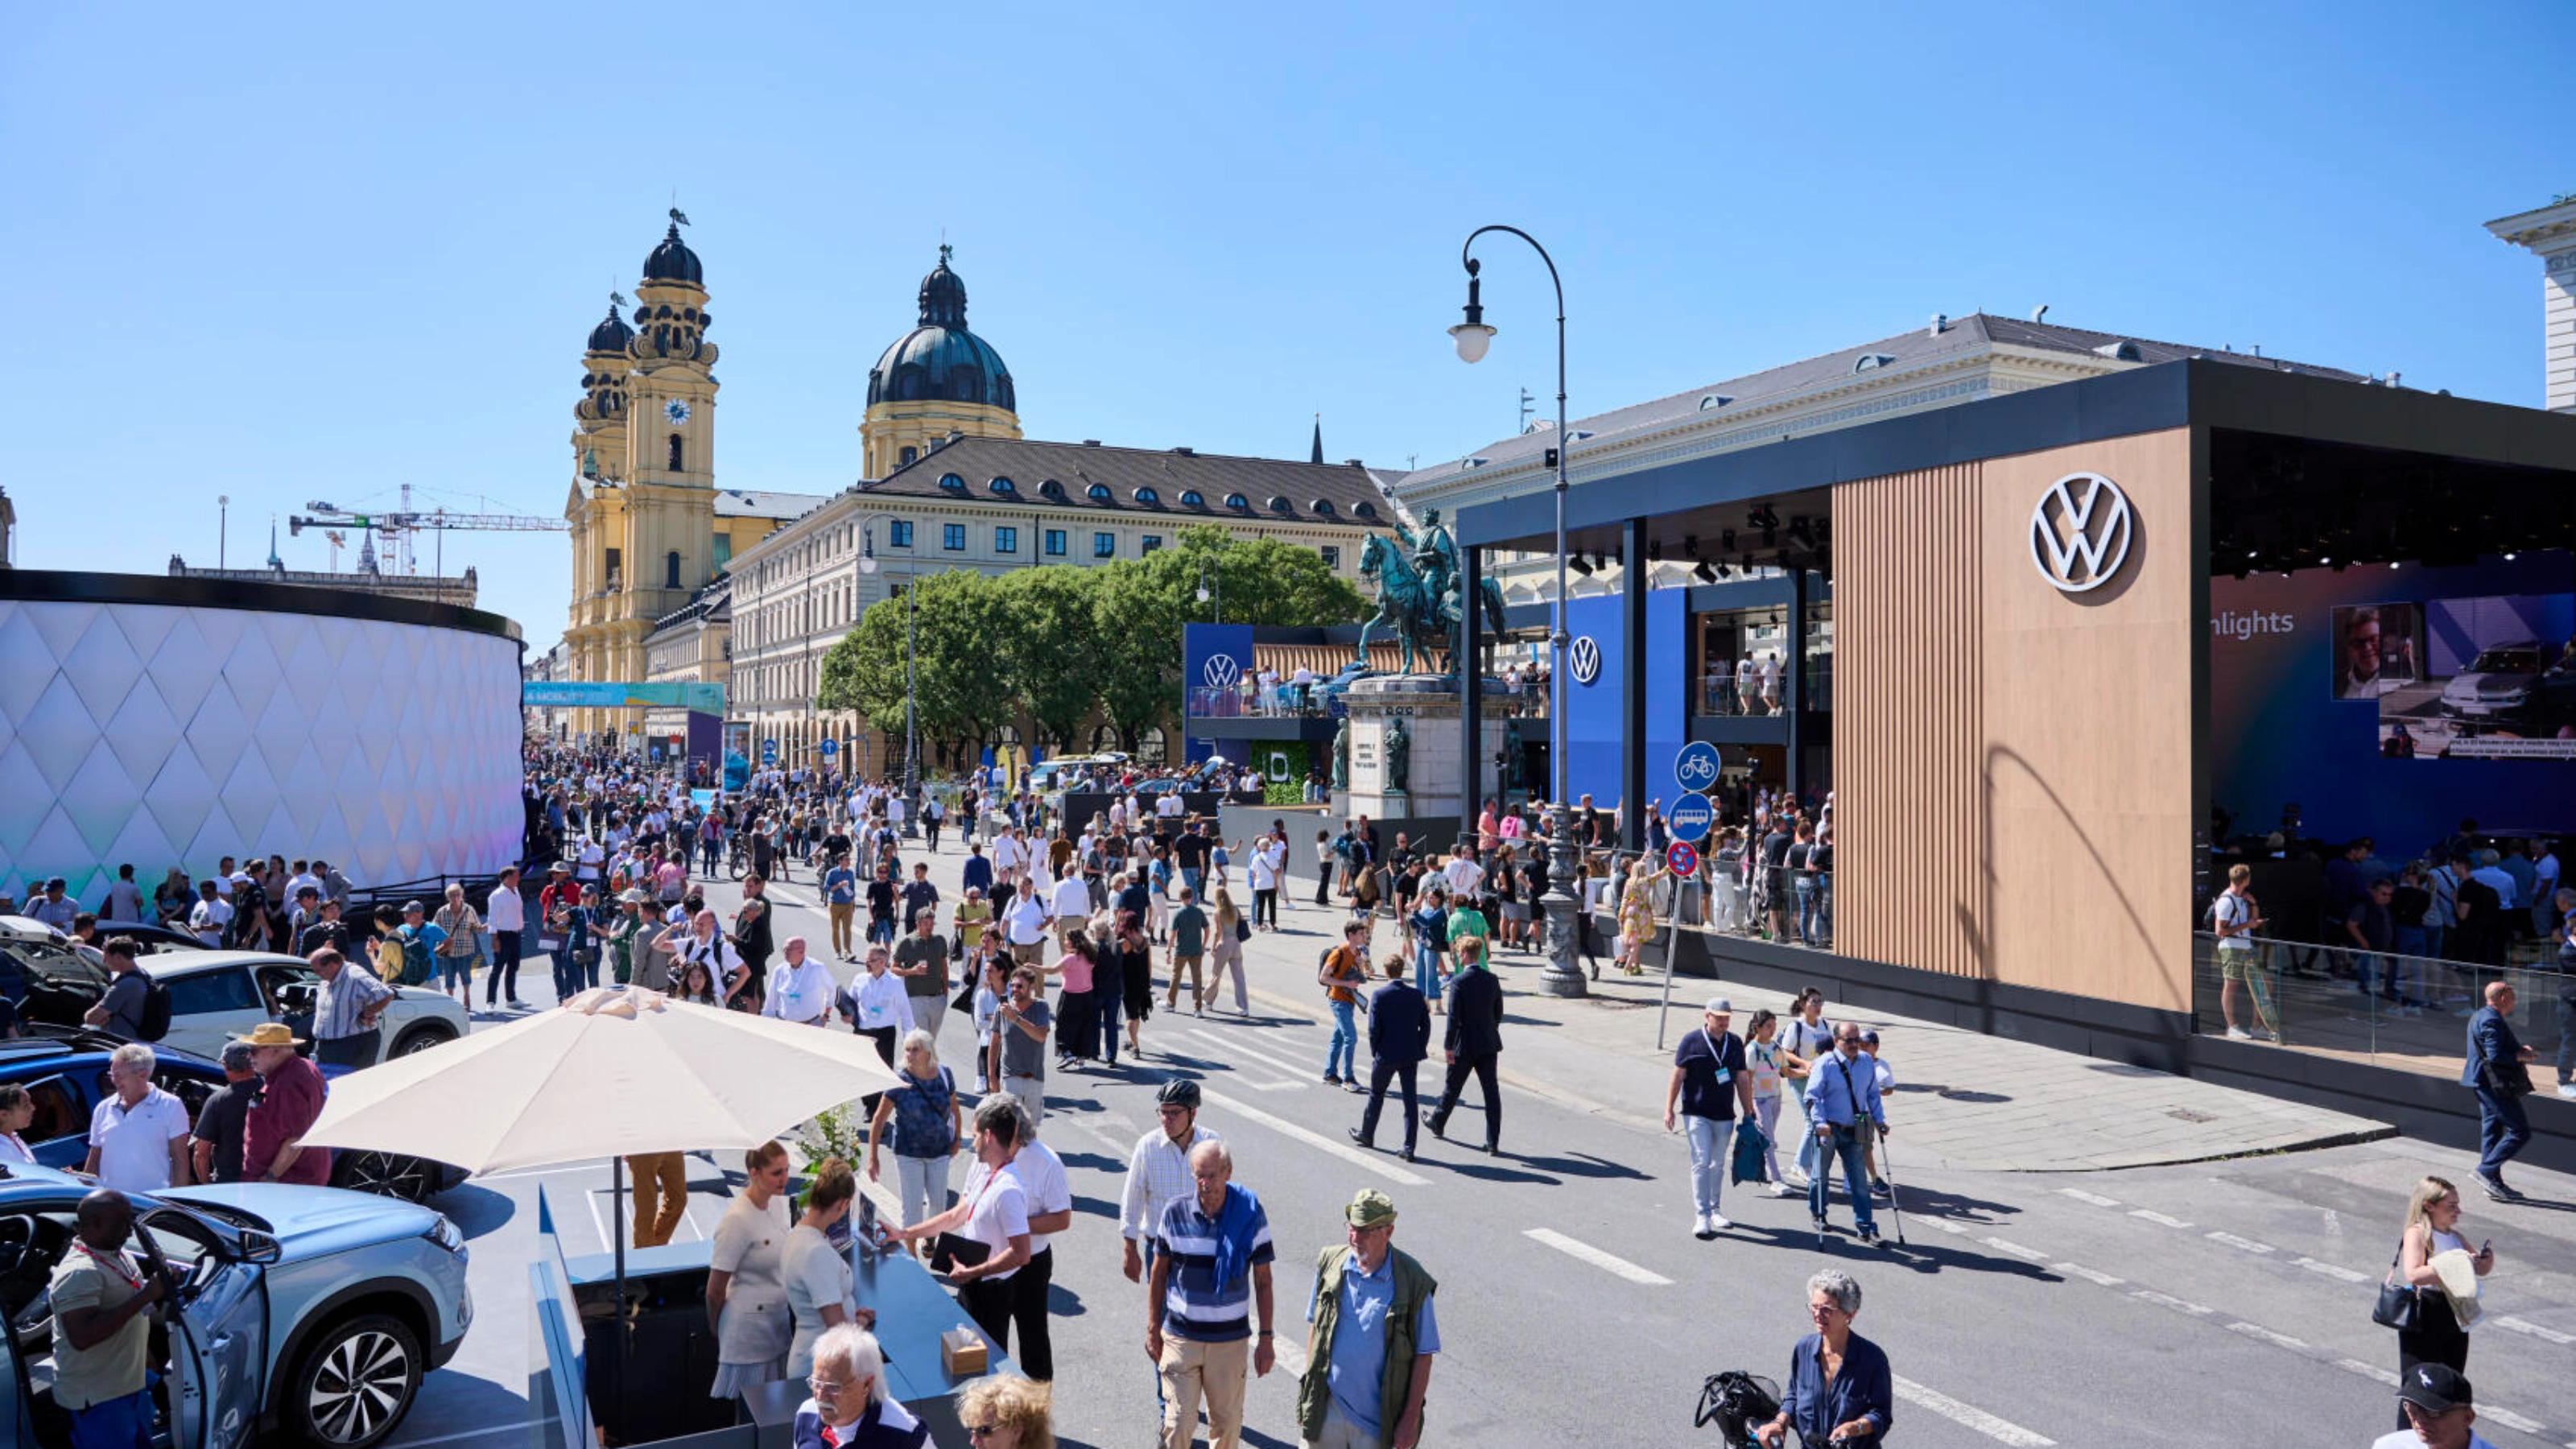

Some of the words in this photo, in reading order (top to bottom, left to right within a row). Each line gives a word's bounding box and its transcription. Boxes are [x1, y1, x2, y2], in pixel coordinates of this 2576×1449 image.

[2029, 473, 2132, 592] VW
[1204, 654, 1237, 687] VW
[1570, 636, 1598, 683] VW
